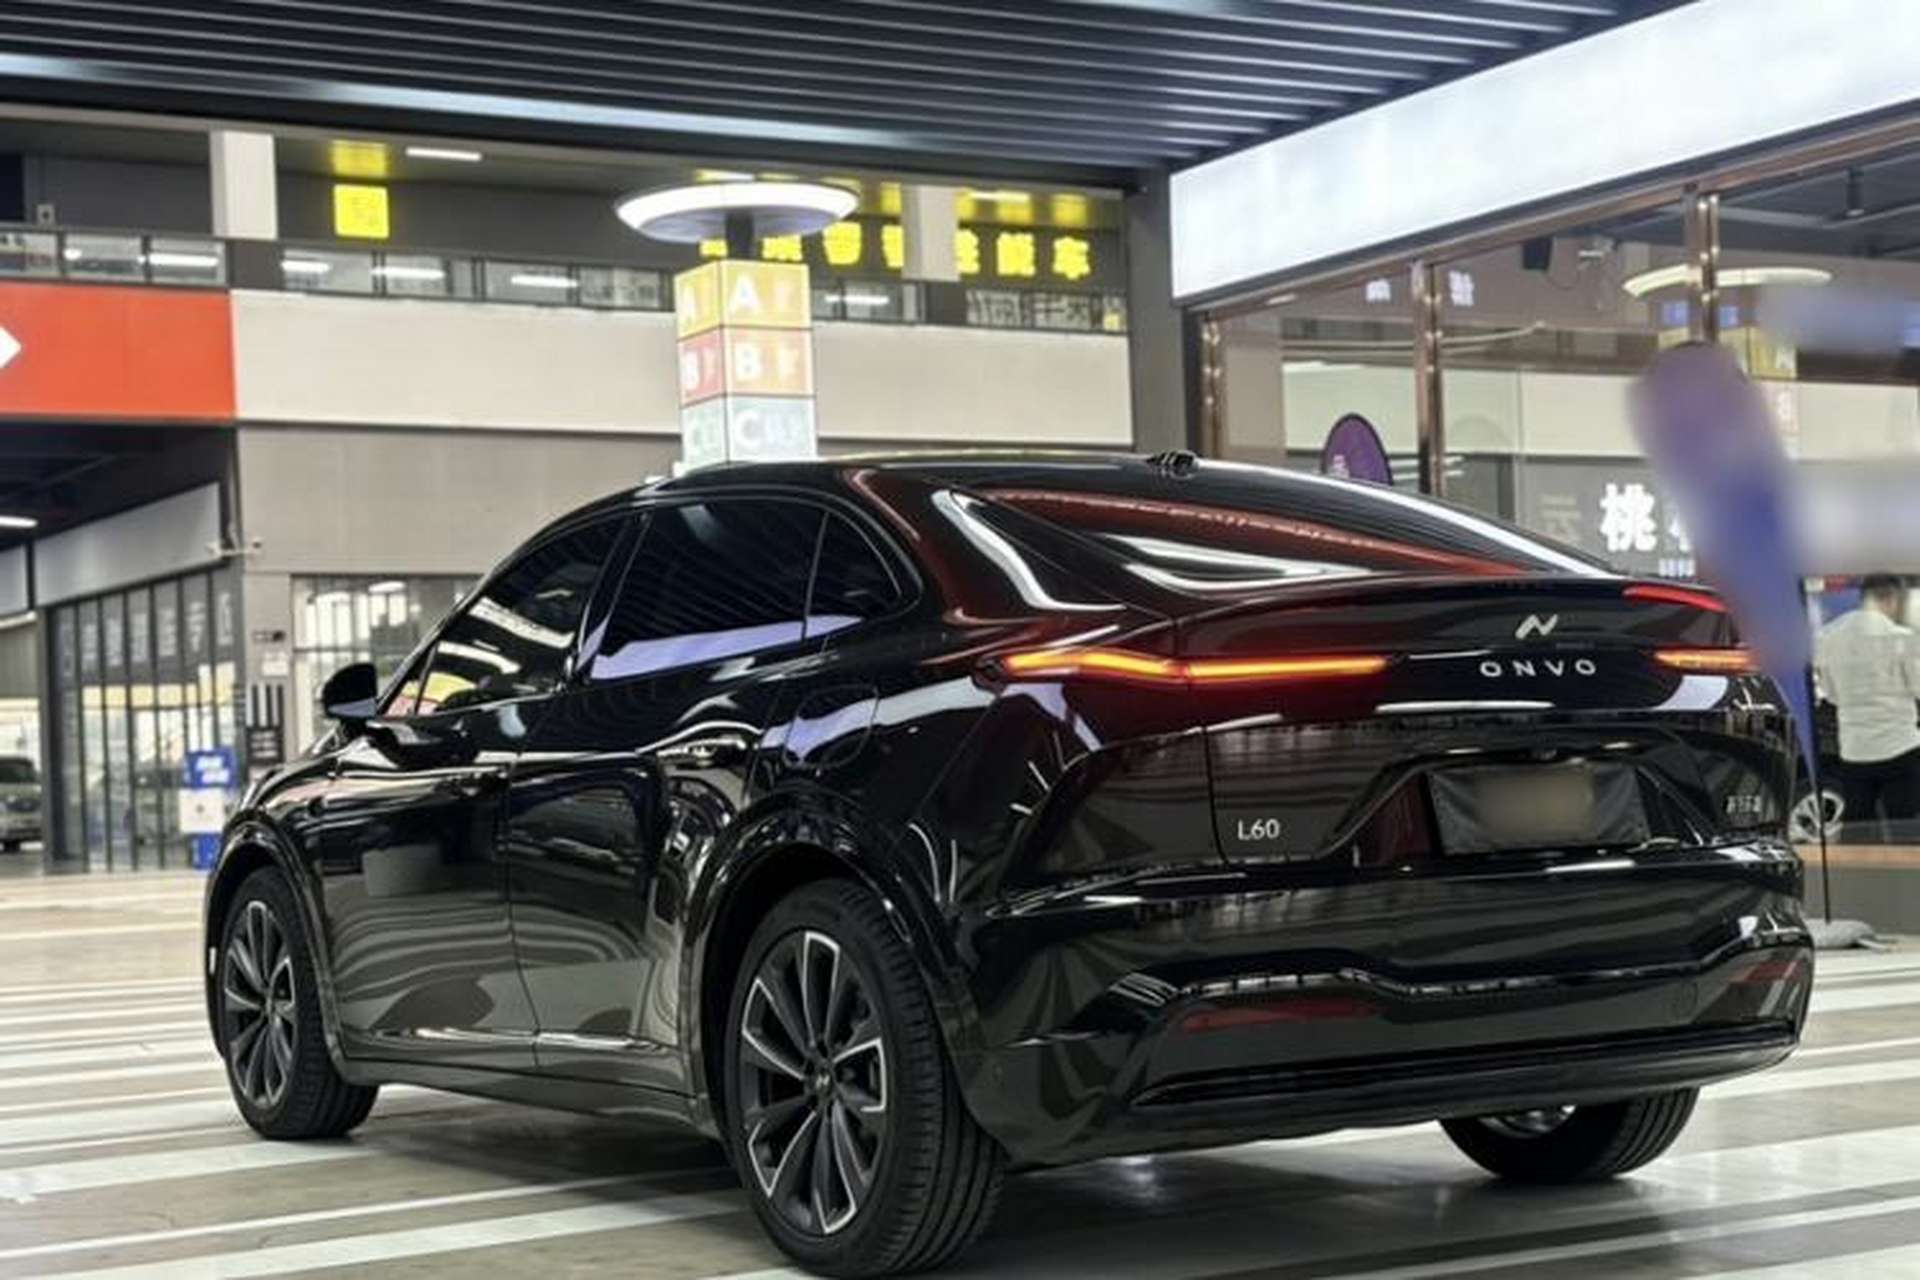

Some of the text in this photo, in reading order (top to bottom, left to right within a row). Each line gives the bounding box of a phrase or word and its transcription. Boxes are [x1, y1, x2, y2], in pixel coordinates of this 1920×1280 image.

[729, 274, 762, 314] A
[735, 342, 761, 382] B
[1479, 659, 1596, 678] ONVO
[1237, 818, 1280, 841] L60
